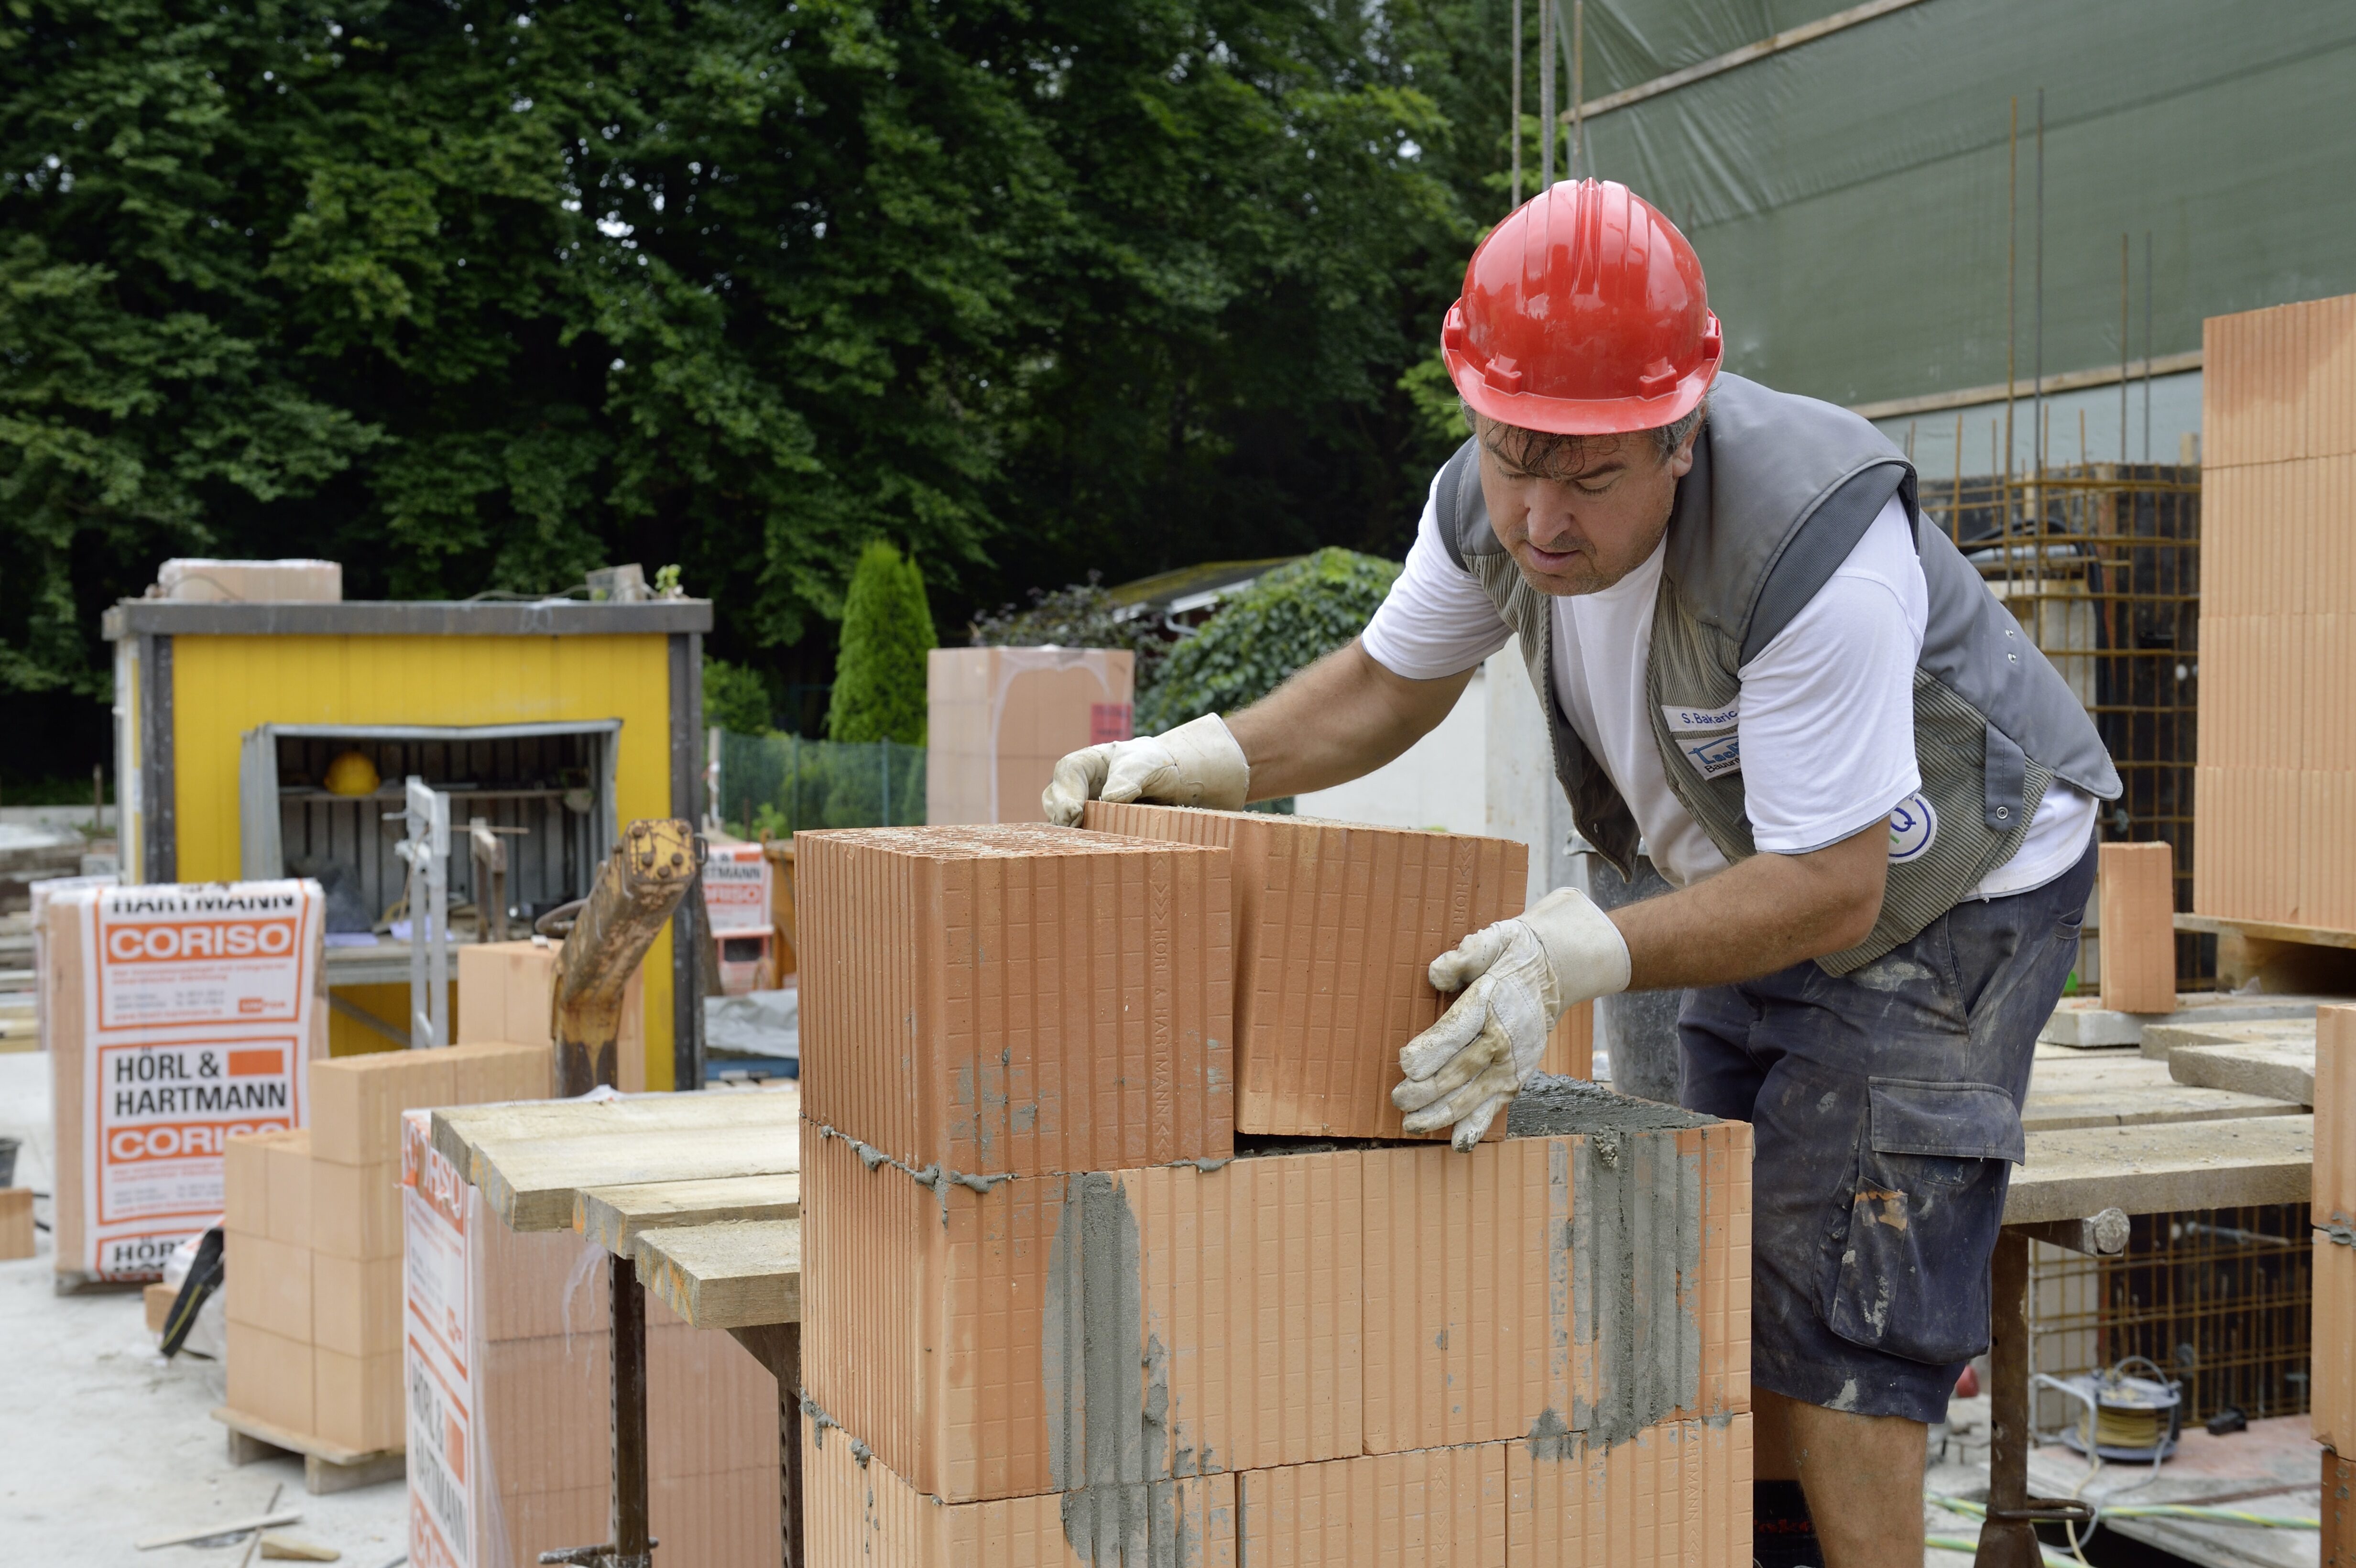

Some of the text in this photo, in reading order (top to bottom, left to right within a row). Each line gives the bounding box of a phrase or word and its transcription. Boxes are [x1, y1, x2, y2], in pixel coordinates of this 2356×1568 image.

[109, 923, 291, 959] CORISO
[116, 1047, 219, 1082] HÖRL &
[115, 1083, 286, 1117] HARTMANN
[110, 1122, 286, 1160] CORI
